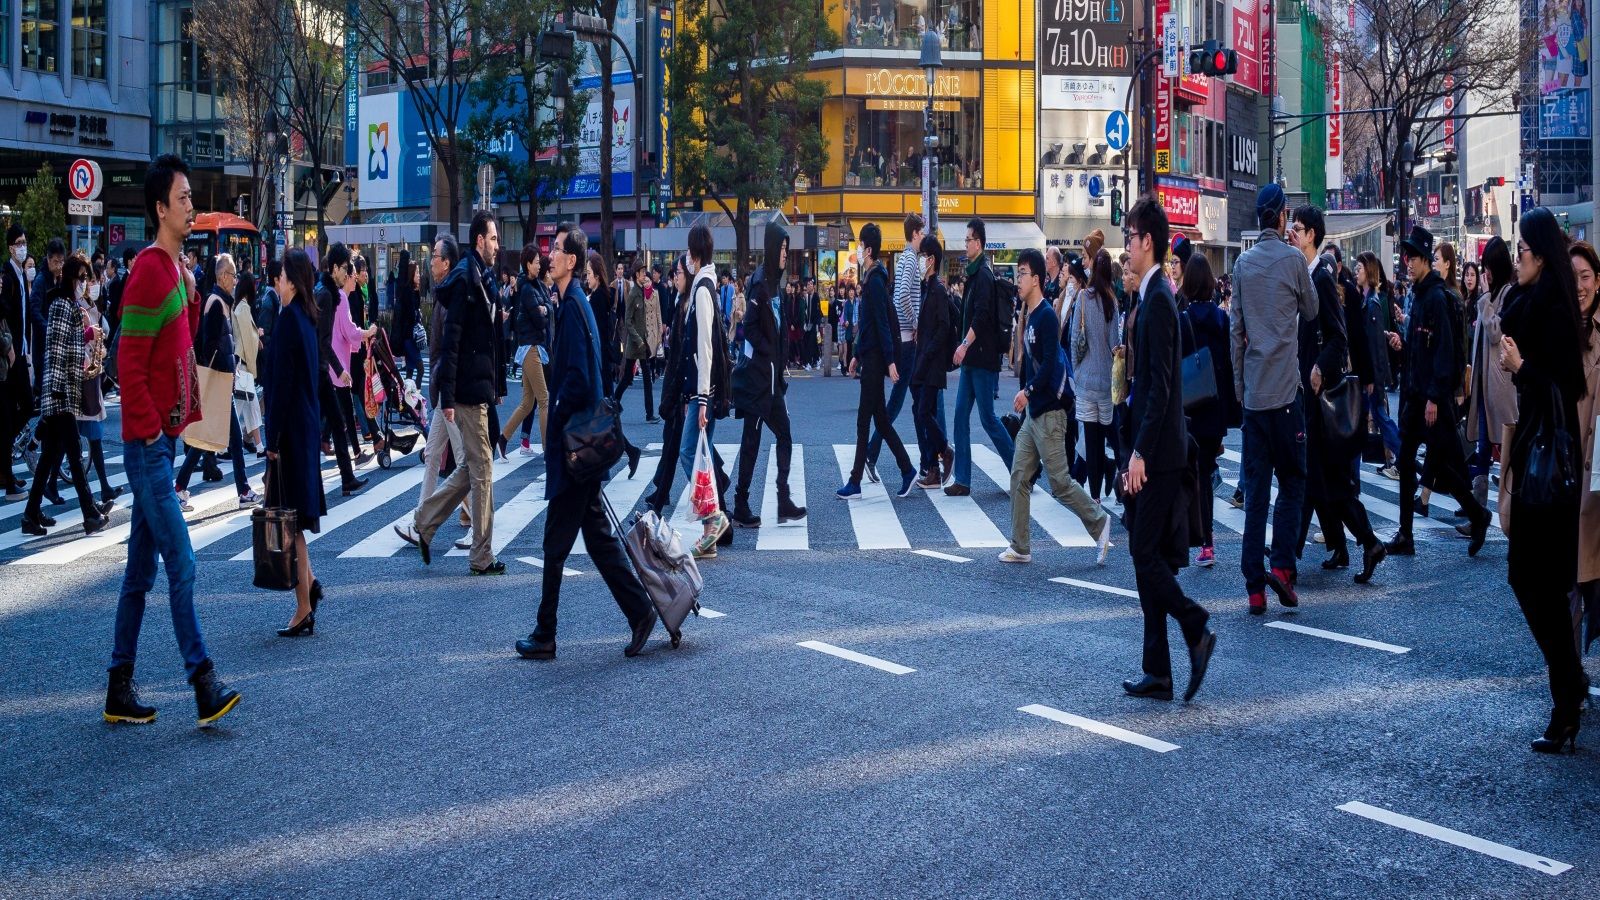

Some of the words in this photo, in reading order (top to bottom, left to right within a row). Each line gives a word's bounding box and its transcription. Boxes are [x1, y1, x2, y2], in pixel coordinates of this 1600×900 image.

[1054, 0, 1125, 22] 7月9日(土)
[1237, 16, 1255, 52] アコム
[1046, 28, 1129, 67] 7月10日(日)
[883, 100, 895, 109] EN
[899, 101, 944, 111] PROVECE
[187, 145, 206, 154] MRK
[1232, 135, 1258, 175] LUSH
[1158, 151, 1168, 169] 薬
[70, 204, 93, 213] ここまで
